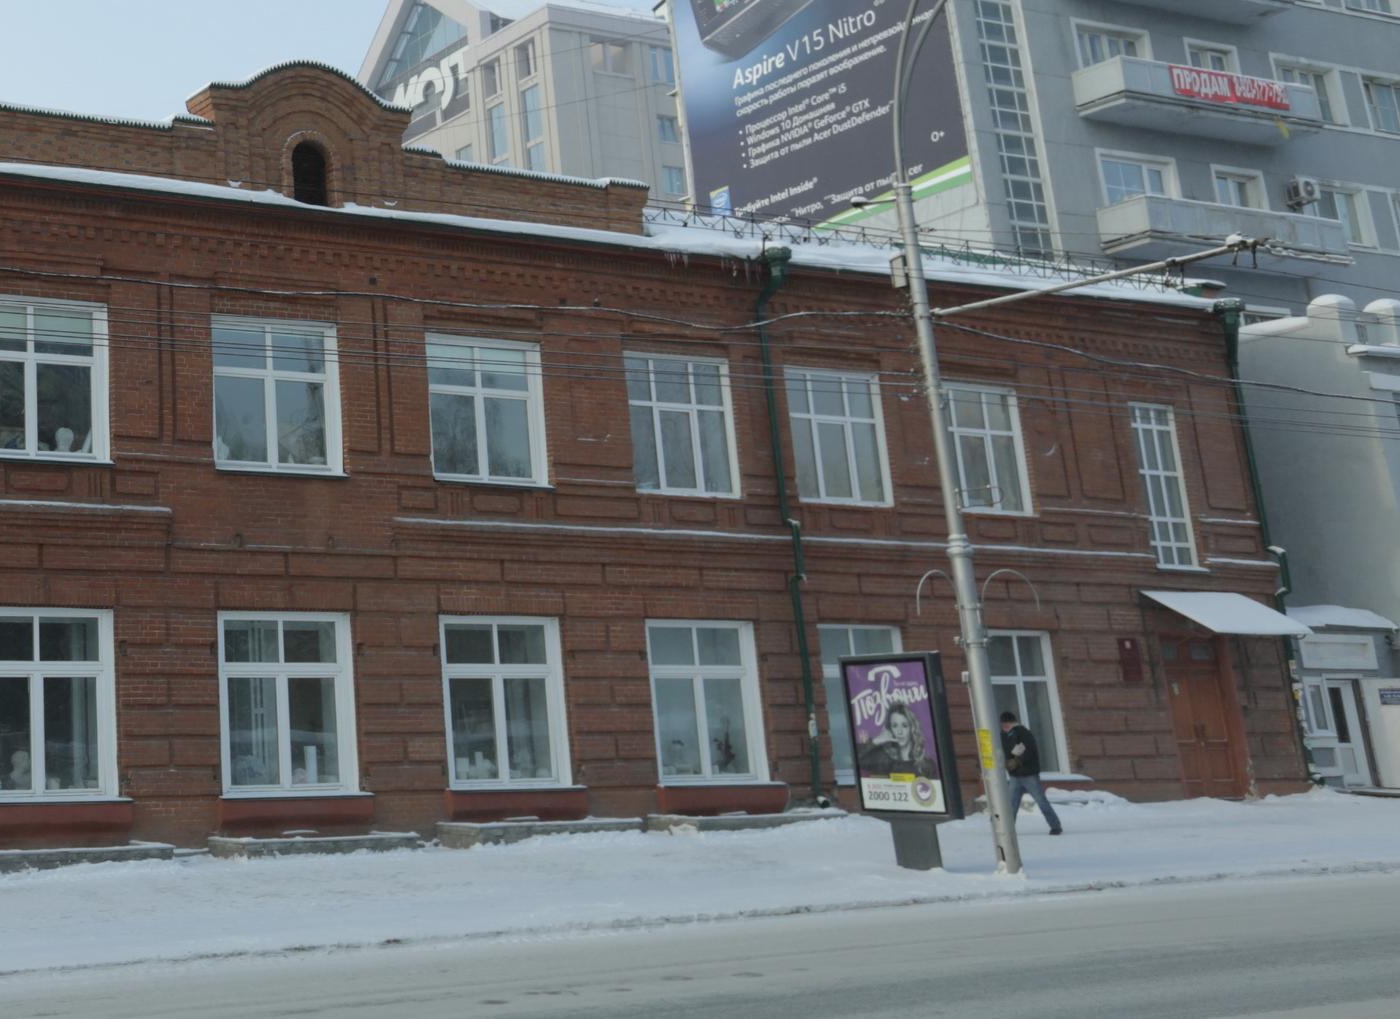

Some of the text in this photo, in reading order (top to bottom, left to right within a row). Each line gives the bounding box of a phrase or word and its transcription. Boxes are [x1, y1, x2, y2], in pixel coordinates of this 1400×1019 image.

[732, 10, 876, 89] Aspire V 15 Nitro
[768, 84, 798, 104] работы
[1172, 68, 1230, 98] ПРОДАМ
[745, 110, 788, 134] Процессор
[838, 82, 847, 94] i5
[746, 126, 780, 146] Windows
[780, 119, 792, 131] 10
[748, 138, 781, 158] Графика
[851, 97, 871, 113] GTX
[750, 150, 780, 169] Защита
[779, 146, 790, 156] от
[813, 127, 832, 143] Acer
[769, 188, 789, 204] Intel
[868, 790, 909, 802] 2000 122
